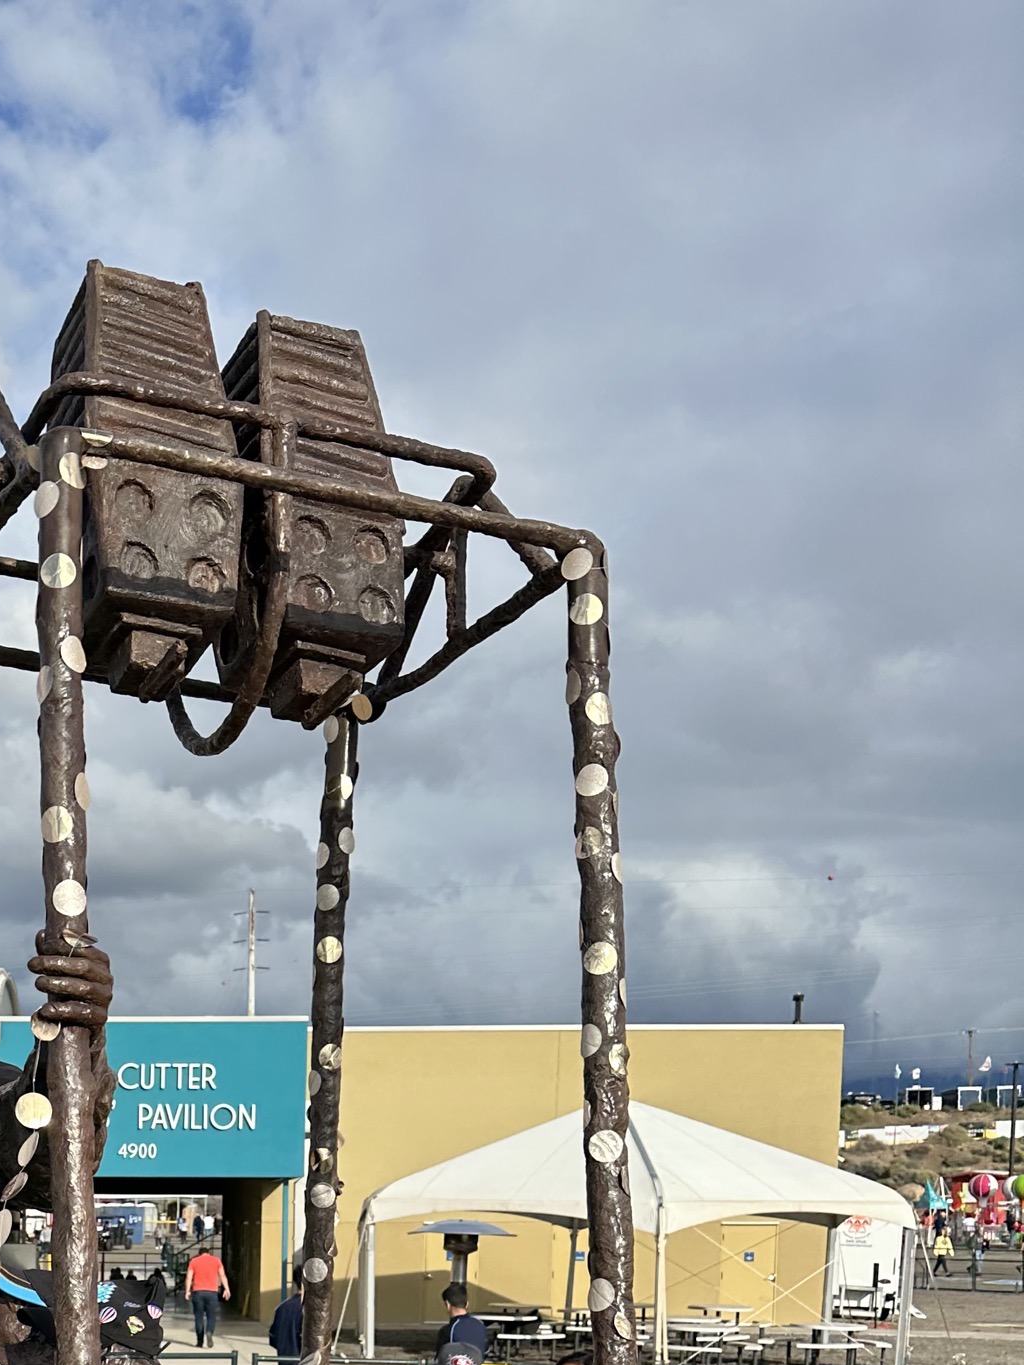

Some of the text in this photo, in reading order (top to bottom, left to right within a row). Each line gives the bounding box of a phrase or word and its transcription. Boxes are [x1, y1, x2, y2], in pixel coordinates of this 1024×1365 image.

[117, 1062, 217, 1090] CUTTER
[137, 1103, 257, 1131] PAVILION
[117, 1142, 158, 1159] 4900
